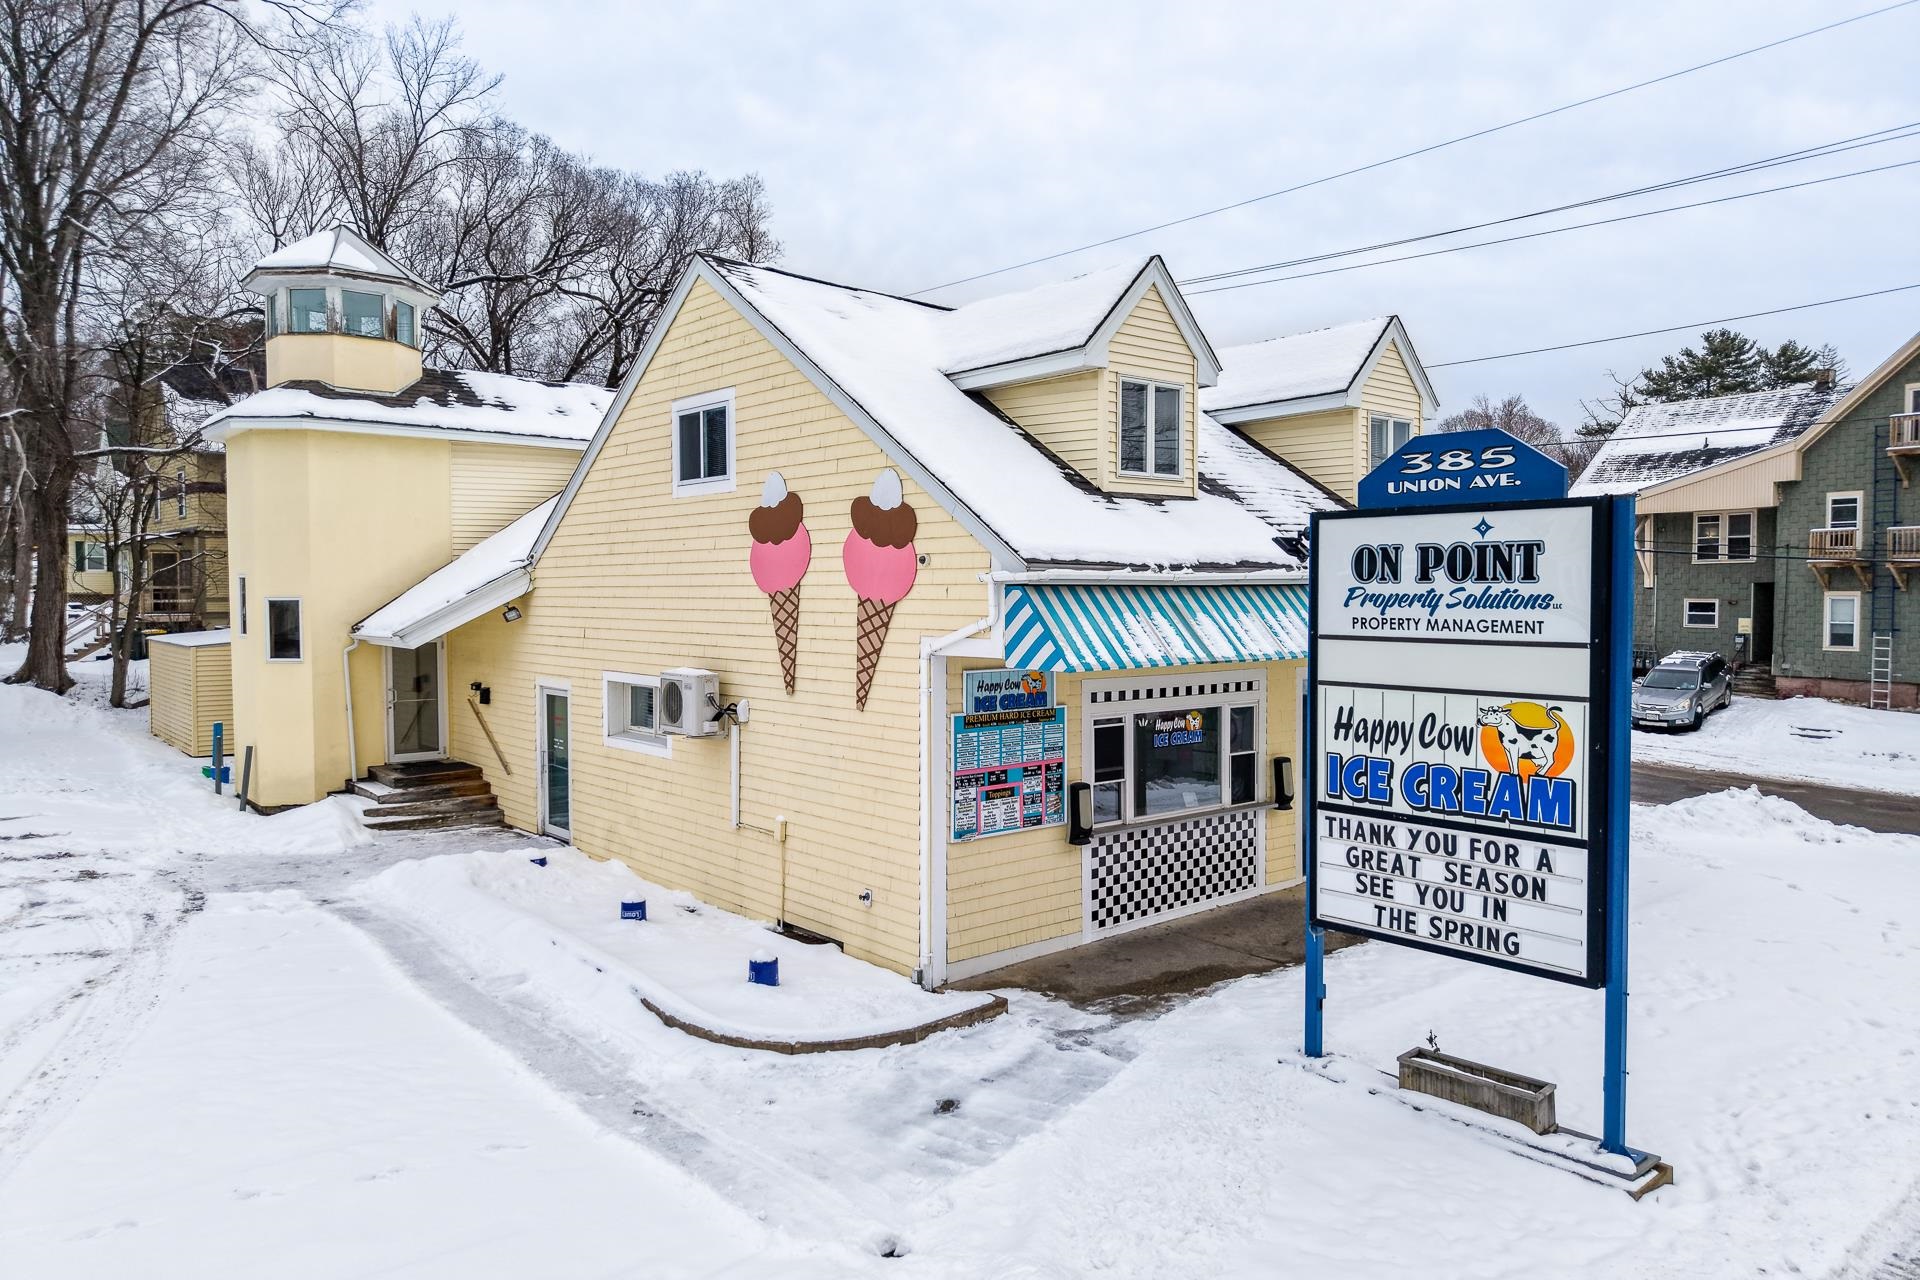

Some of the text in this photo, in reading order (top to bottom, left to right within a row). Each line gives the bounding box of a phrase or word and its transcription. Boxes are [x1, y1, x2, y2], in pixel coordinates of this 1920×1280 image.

[1400, 445, 1517, 474] 385
[1387, 473, 1521, 495] UNION AVE.
[1351, 540, 1545, 584] ON POINT
[1343, 587, 1444, 616] Property
[1445, 585, 1554, 610] Solutions
[1351, 616, 1545, 635] PROPERTY MANAGEMENT
[977, 678, 1021, 693] Happy Cow
[965, 714, 998, 723] PREMIUM
[1000, 711, 1019, 721] HARD
[1032, 709, 1056, 718] CREAM
[974, 691, 1047, 713] ICE CREAM
[1154, 730, 1202, 747] ICE CREAM
[1155, 717, 1186, 732] Happy Cow
[1333, 706, 1475, 756] Happy Cow
[1327, 752, 1577, 833] ICE CREAM
[1325, 816, 1553, 873] THANK YOU FOR A
[1346, 847, 1546, 902] GREAT SEASON
[1356, 874, 1507, 922] SEE YOU IN
[1374, 905, 1520, 955] THE SPRING
